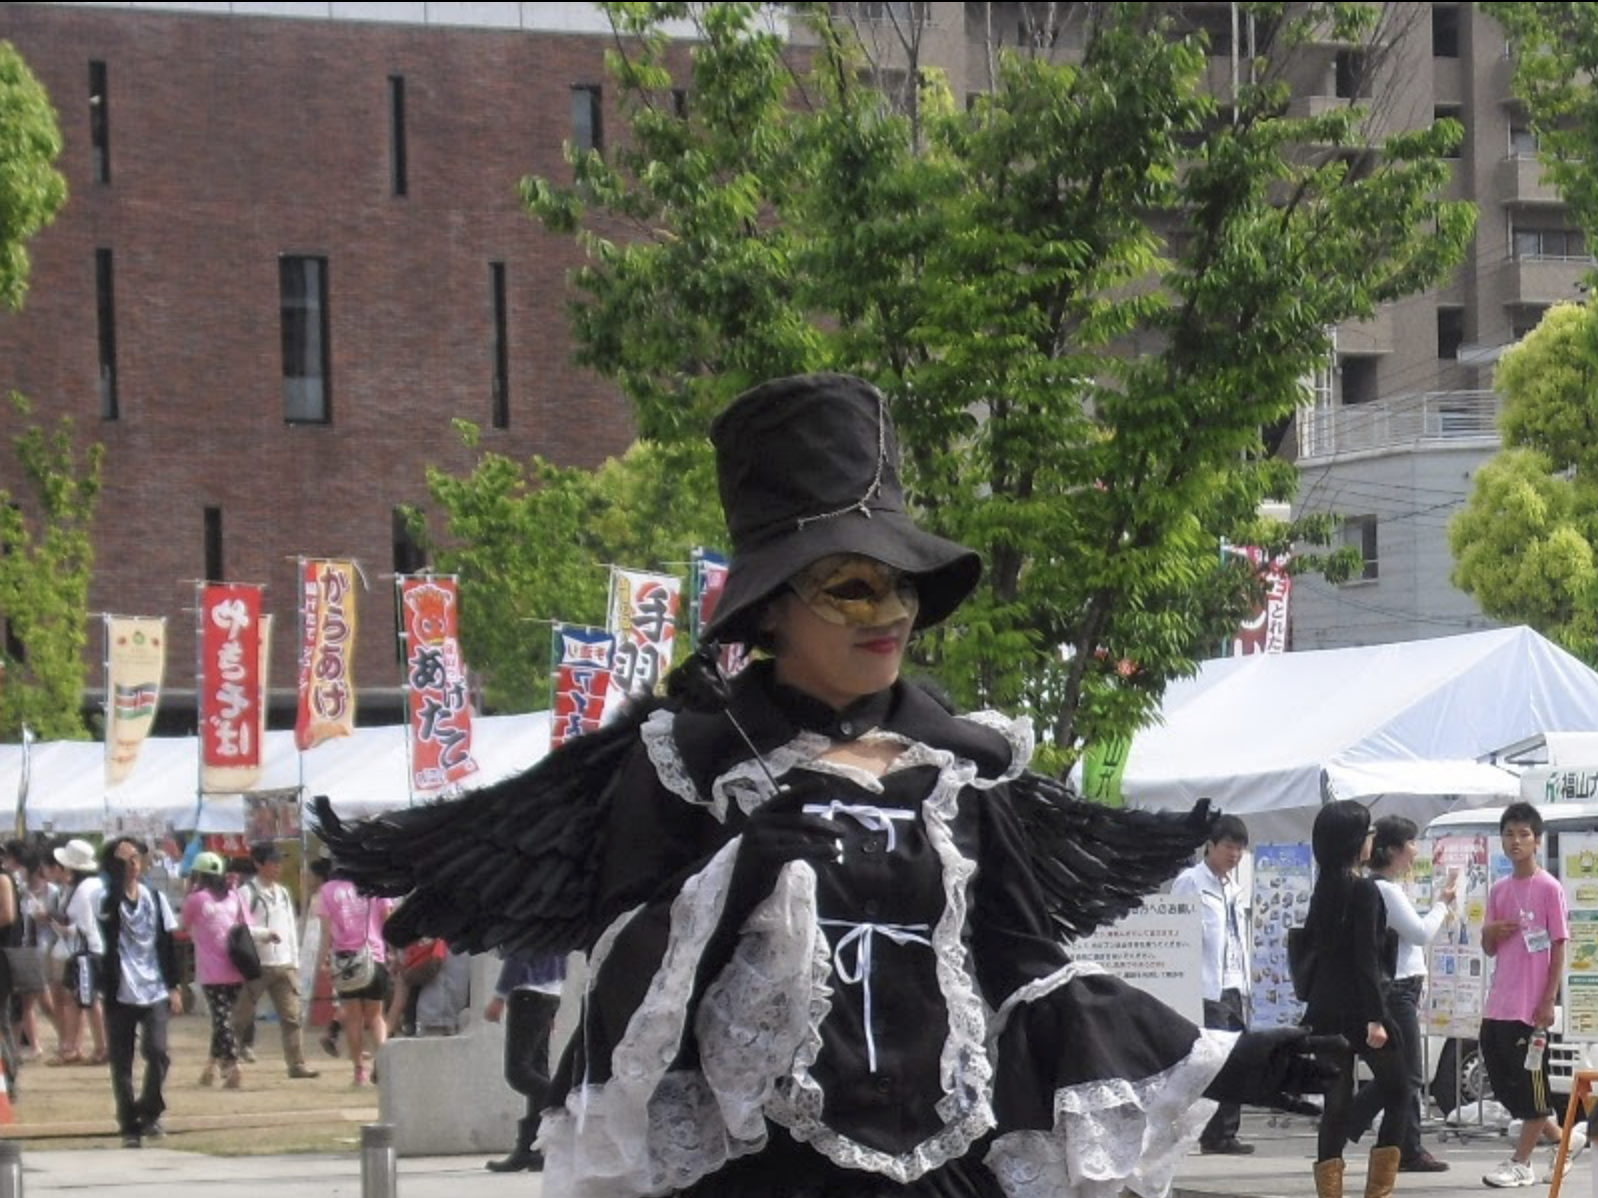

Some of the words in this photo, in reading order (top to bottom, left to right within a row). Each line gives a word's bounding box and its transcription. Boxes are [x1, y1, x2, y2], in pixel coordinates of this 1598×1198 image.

[211, 599, 250, 757] やきそば
[315, 566, 350, 719] からあげ
[409, 647, 467, 769] あげたて
